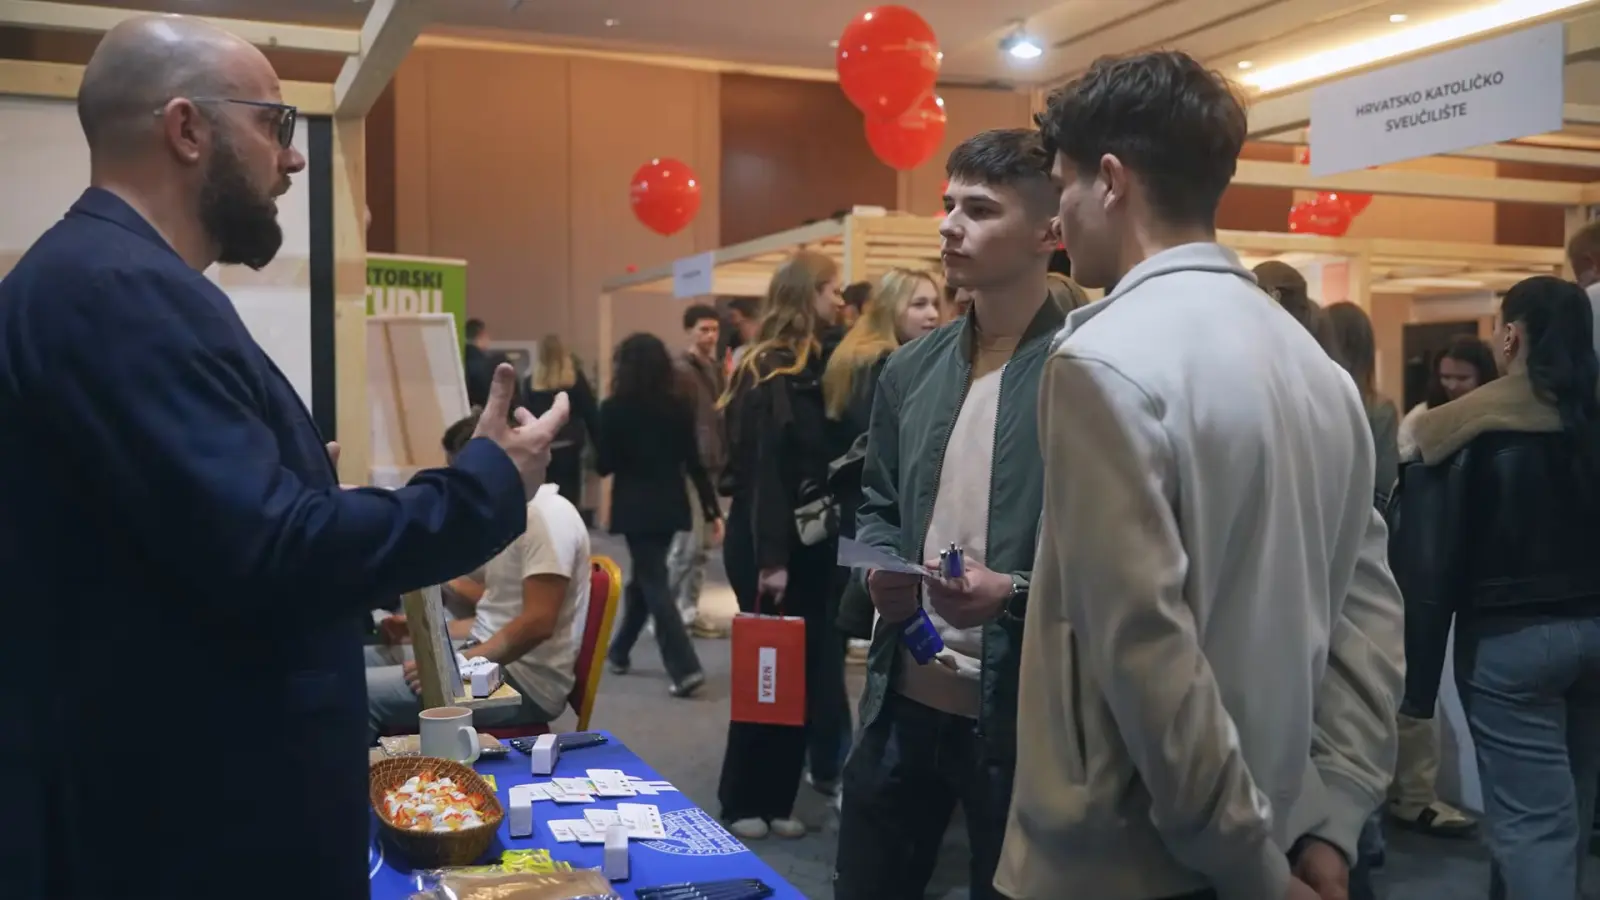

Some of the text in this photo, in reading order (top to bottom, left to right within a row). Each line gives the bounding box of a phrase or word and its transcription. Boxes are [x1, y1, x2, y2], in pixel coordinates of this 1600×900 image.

[1355, 71, 1504, 117] HRVATSKO KATOLIČKO
[1385, 102, 1467, 132] SVEUČILIŠTE
